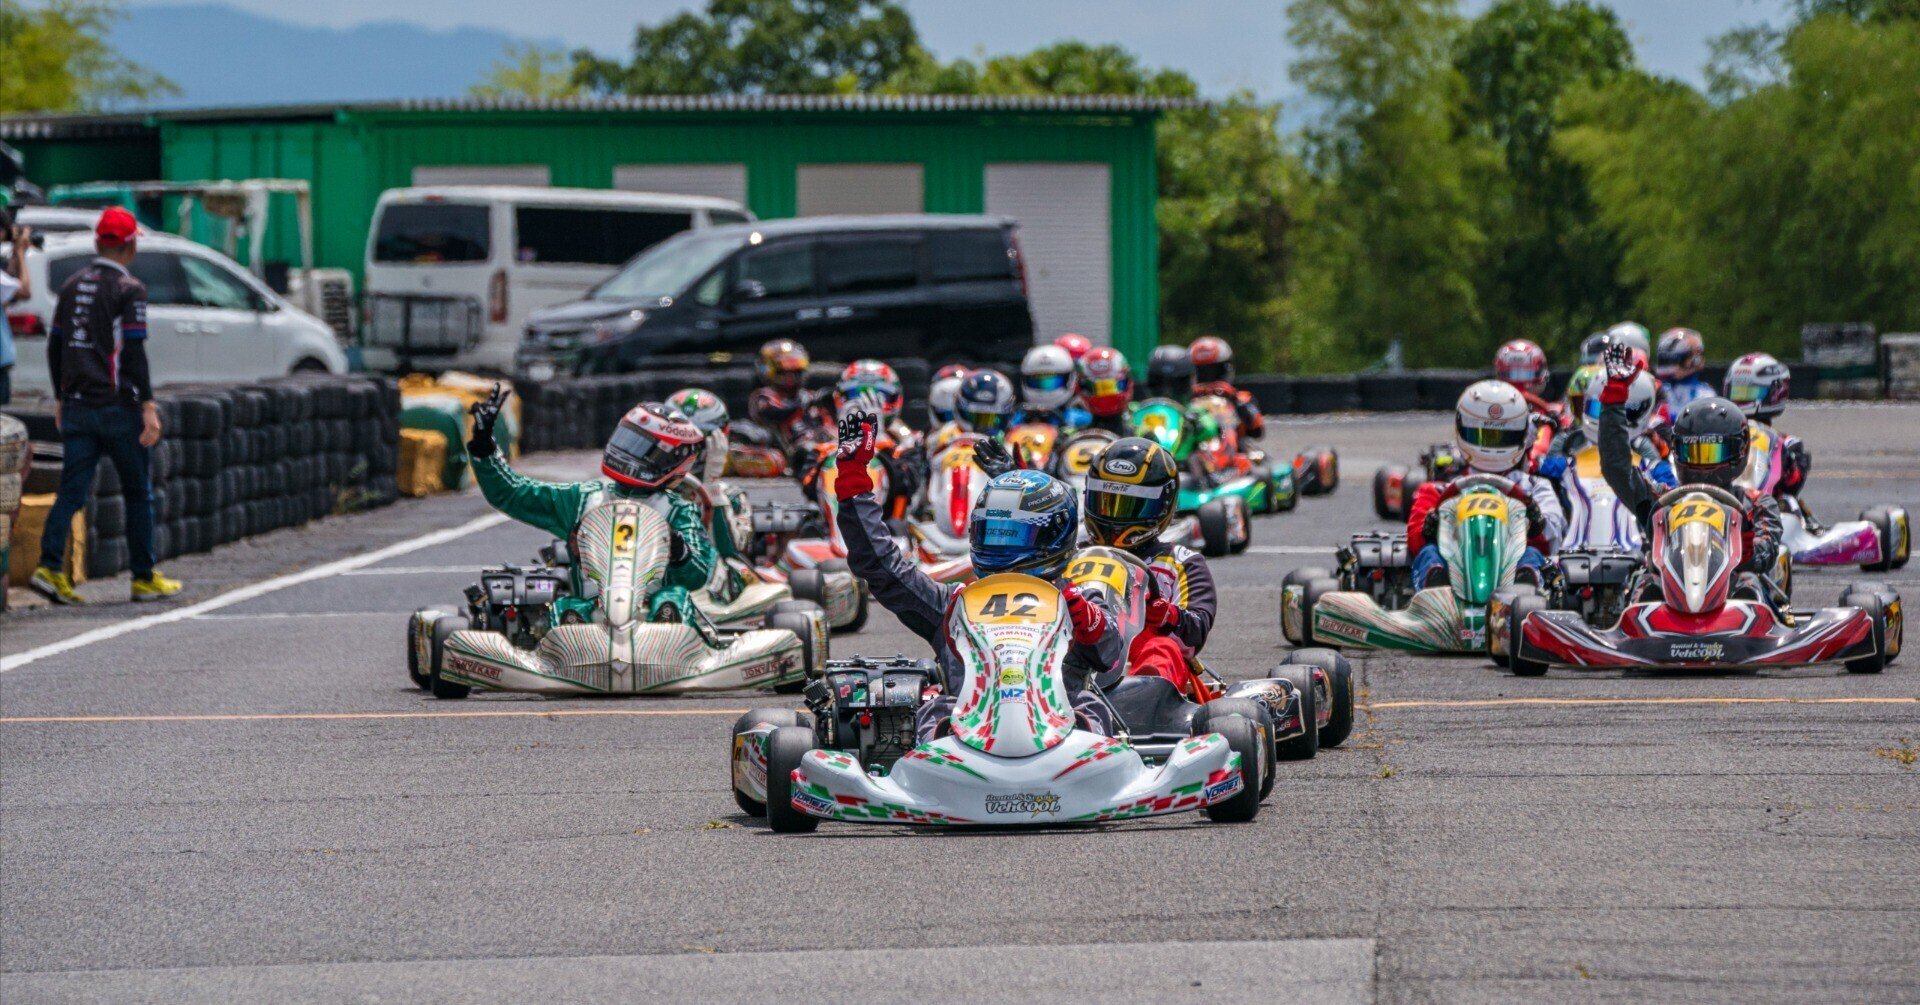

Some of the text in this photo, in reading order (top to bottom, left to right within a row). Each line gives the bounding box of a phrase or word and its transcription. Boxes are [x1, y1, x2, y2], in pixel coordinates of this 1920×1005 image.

[1112, 461, 1132, 471] Arai
[1467, 498, 1501, 512] 16
[1675, 504, 1718, 521] 47
[1070, 561, 1116, 579] 91
[979, 592, 1040, 618] 42
[994, 630, 1034, 638] YAMAHA
[1205, 775, 1240, 800] VORTEX
[793, 787, 833, 813] VORTEX
